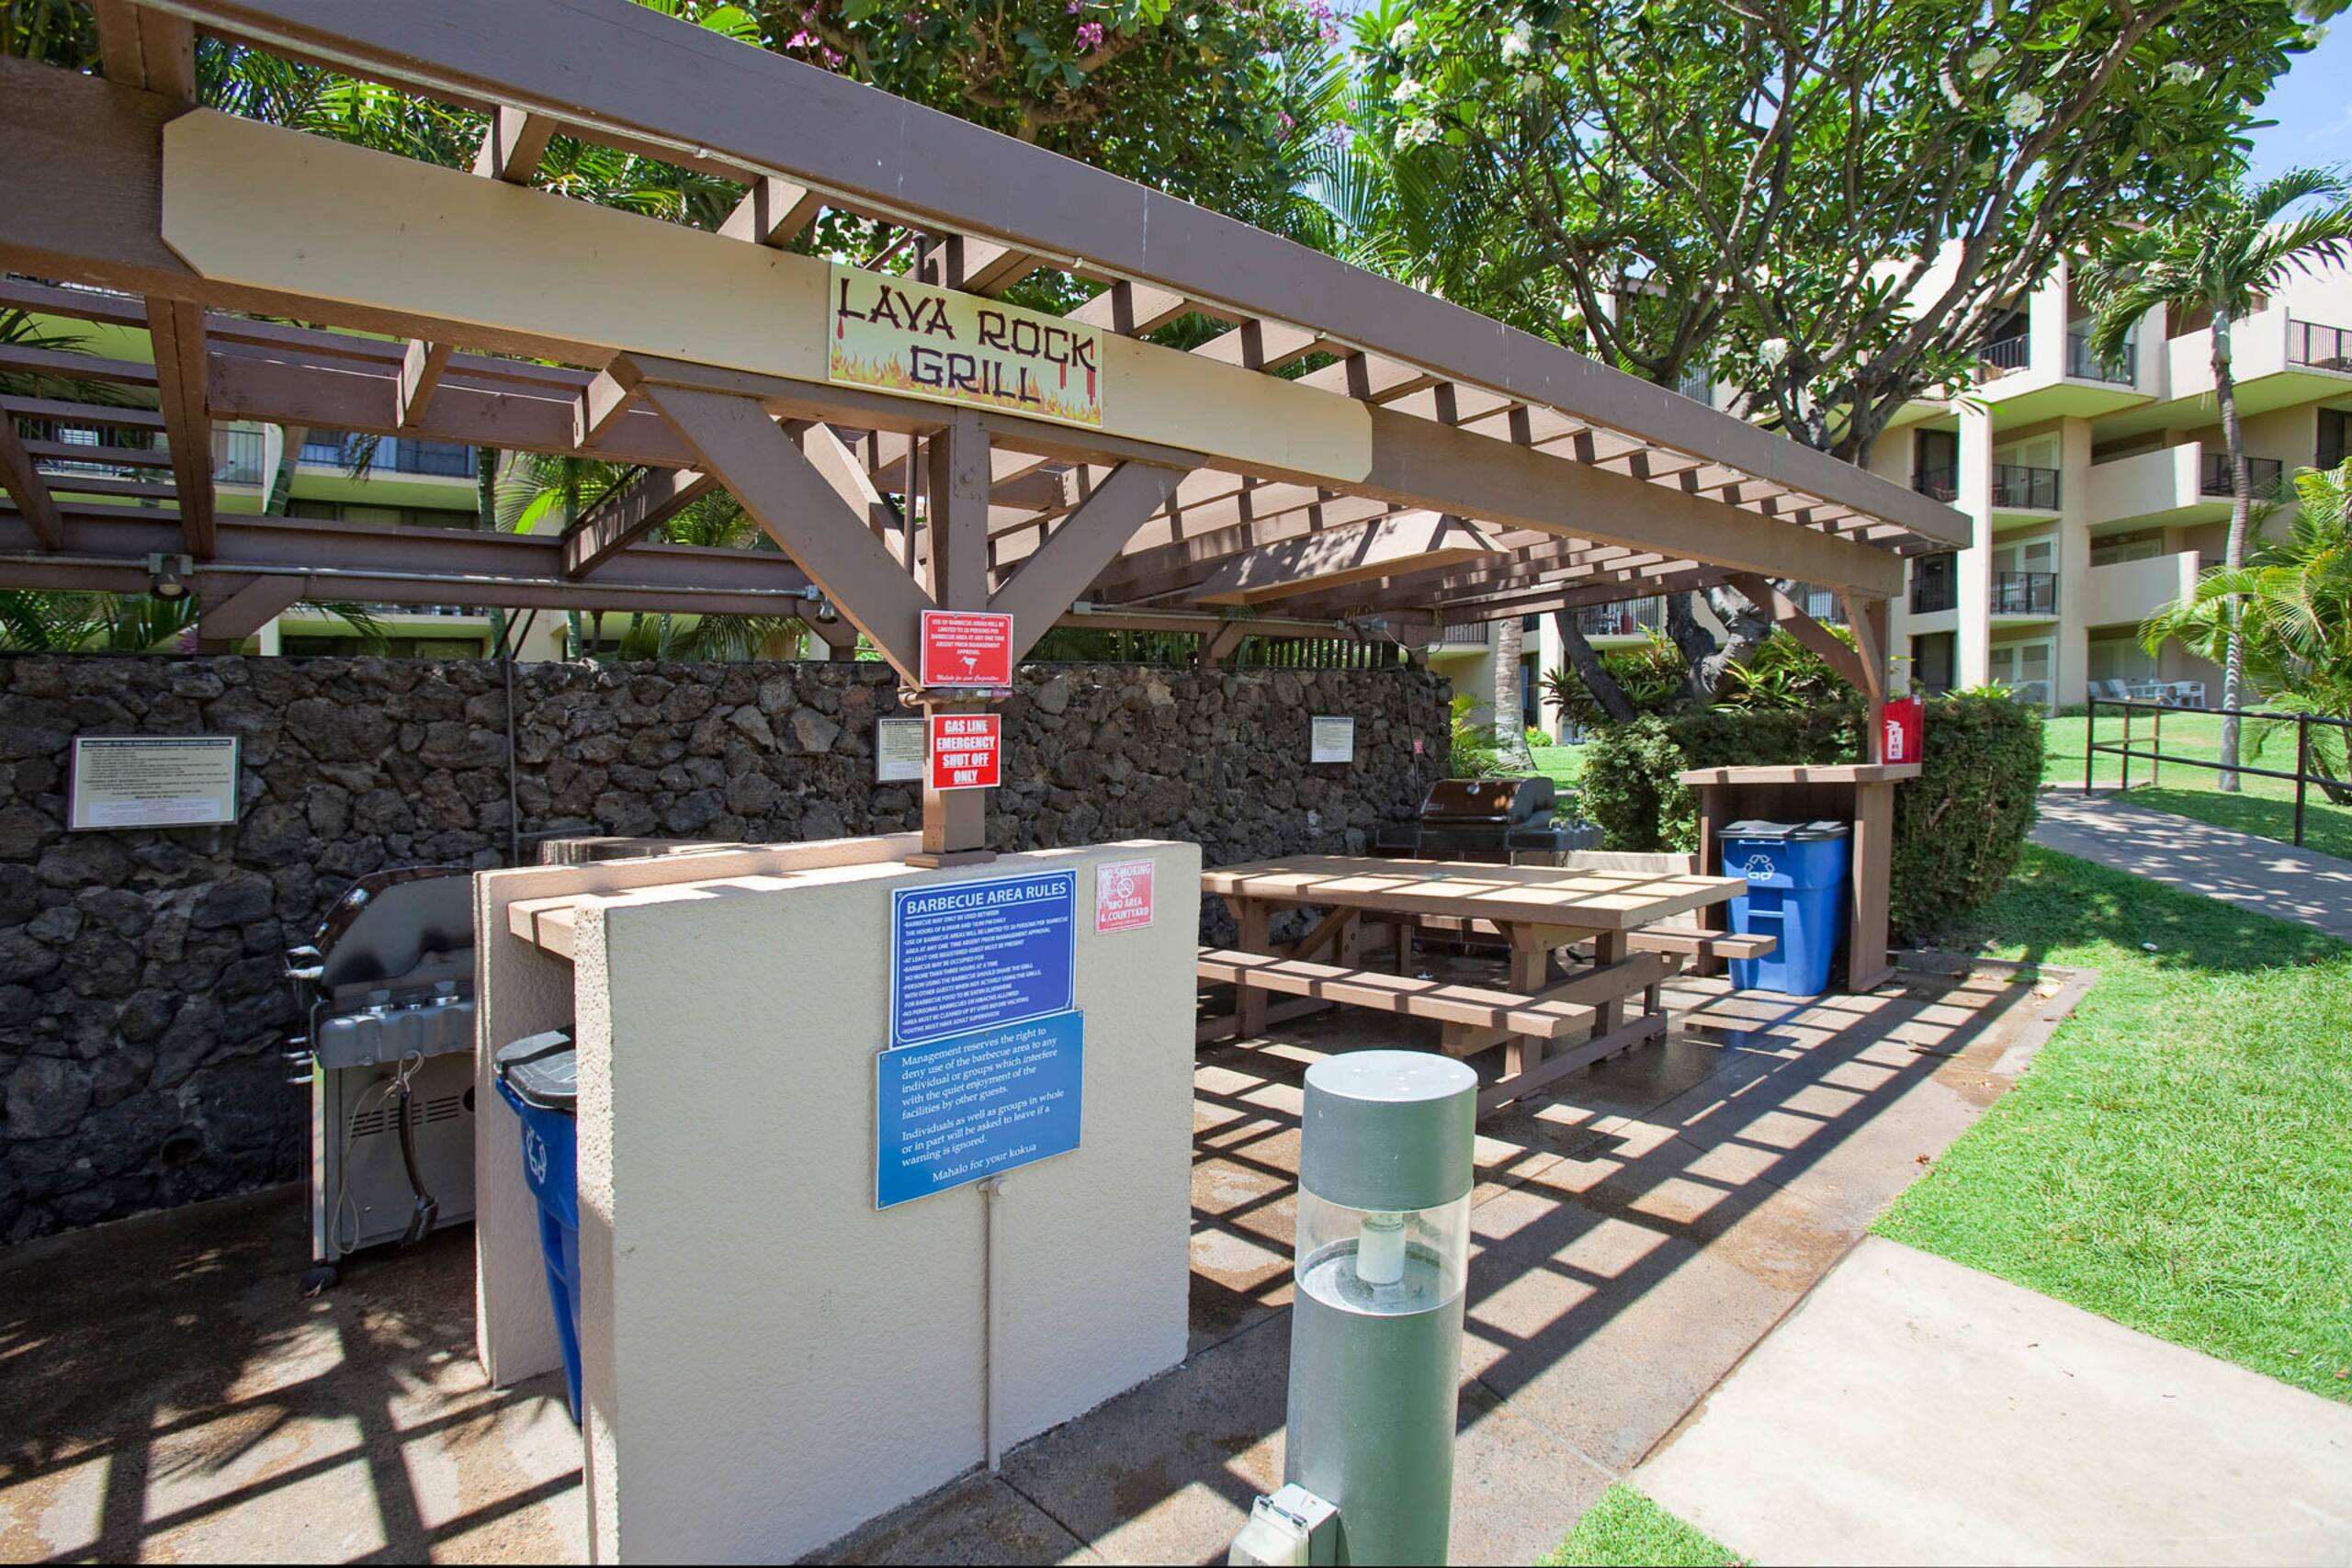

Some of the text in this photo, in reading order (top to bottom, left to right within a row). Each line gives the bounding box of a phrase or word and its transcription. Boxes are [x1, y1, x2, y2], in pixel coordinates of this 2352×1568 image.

[837, 277, 1096, 372] LAVA ROCK
[910, 344, 1041, 404] GRILL
[937, 736, 995, 750] EMERGENCY
[944, 720, 988, 733] GAS LINE
[943, 752, 989, 767] SHUT OFF
[954, 770, 978, 783] ONLY
[908, 882, 1066, 914] BARBECUE AREA RULES
[1109, 908, 1148, 921] COURTYARD
[1125, 897, 1143, 906] AREA
[902, 1045, 961, 1066] Management
[964, 1039, 998, 1052] reserves
[1001, 1034, 1014, 1043] the
[1016, 1030, 1035, 1042] right
[902, 1069, 925, 1079] deny
[929, 1065, 943, 1074] use
[945, 1059, 955, 1069] of
[956, 1057, 970, 1066] the
[972, 1049, 1011, 1063] barbecue
[1012, 1044, 1030, 1054] area
[1042, 1038, 1057, 1051] any
[902, 1074, 949, 1093] individual
[963, 1066, 992, 1080] groups
[995, 1057, 1022, 1069] which
[1023, 1050, 1057, 1063] interfere
[902, 1066, 1036, 1106] with the quiet enjoyment of the
[902, 1087, 1008, 1120] facilities by other guests.
[903, 1119, 954, 1141] Individuals
[967, 1110, 985, 1121] well
[998, 1100, 1027, 1116] groups
[1029, 1097, 1037, 1105] in
[1039, 1089, 1064, 1102] whole
[902, 1145, 911, 1154] or
[915, 1142, 924, 1150] in
[926, 1135, 944, 1150] part
[947, 1128, 963, 1141] will
[965, 1127, 975, 1135] be
[978, 1117, 1001, 1132] asked
[1014, 1111, 1035, 1121] leave
[1037, 1105, 1044, 1115] if
[902, 1134, 987, 1166] warning is ignored.
[933, 1145, 1036, 1181] Mahalo for your kokua
